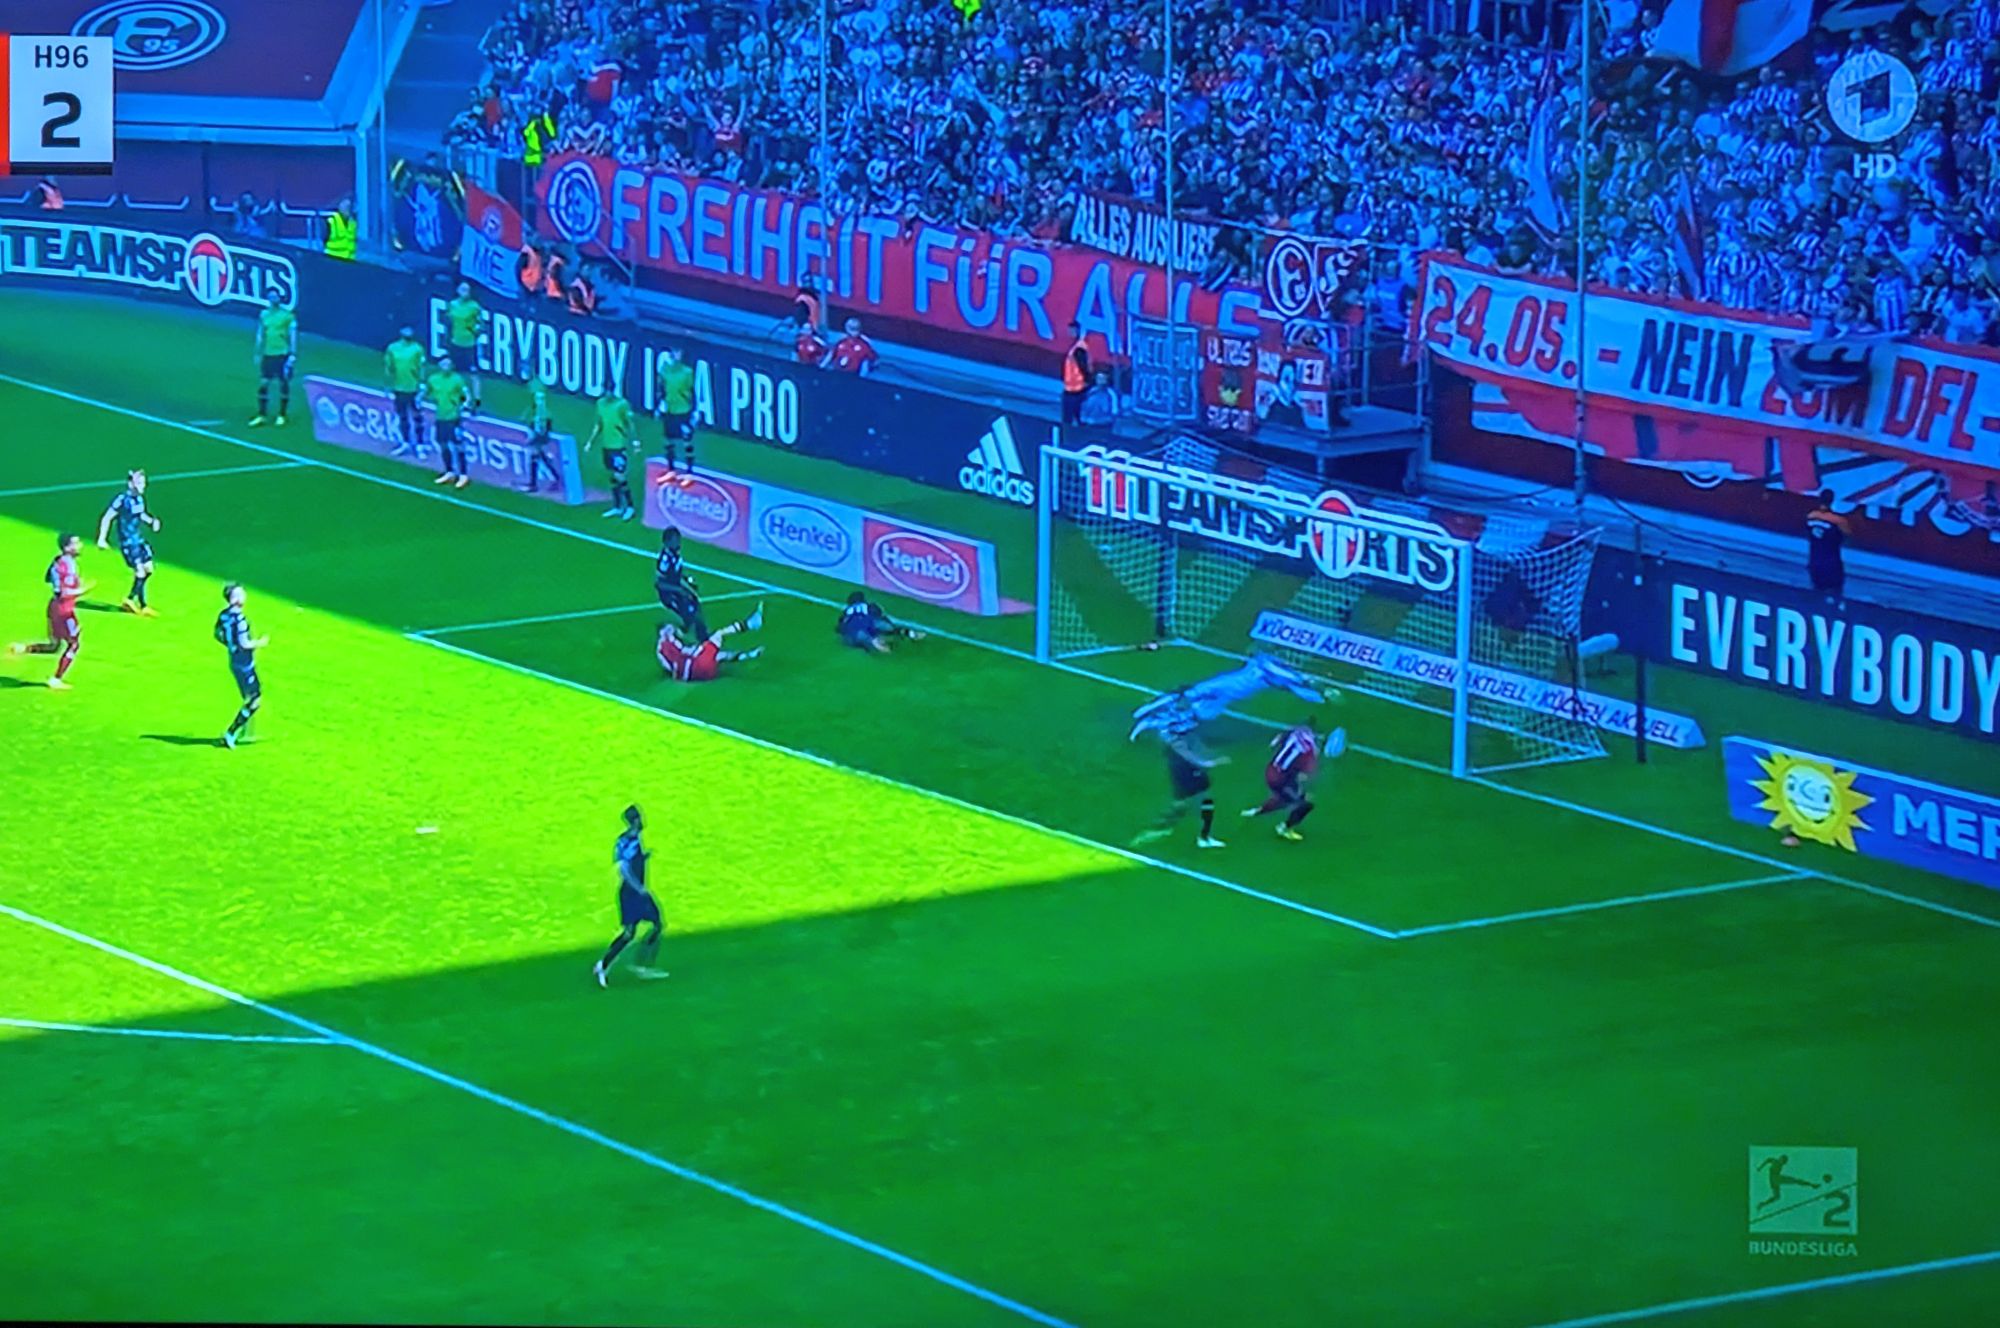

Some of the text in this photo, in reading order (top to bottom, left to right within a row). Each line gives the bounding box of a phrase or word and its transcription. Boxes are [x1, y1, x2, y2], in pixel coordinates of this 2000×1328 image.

[34, 44, 89, 69] H96
[41, 91, 82, 148] 2
[1853, 153, 1897, 179] HD
[1070, 193, 1131, 257] ALLES
[611, 168, 899, 304] FREIHEIT
[913, 228, 1054, 341] FÜR
[1426, 275, 1578, 379] 24.05.
[1631, 319, 1755, 407] NEIN
[430, 298, 628, 398] EERYBODY
[730, 367, 798, 444] PRO
[665, 487, 729, 521] Henkel
[960, 466, 1035, 505] adidas
[767, 515, 844, 552] Henkel
[882, 544, 960, 584] Henkel
[1671, 584, 2000, 733] EVERYBODY
[1258, 617, 1318, 648] KÜCHEN
[1319, 634, 1386, 666] AKTUELL
[1391, 652, 1457, 684] KÜCHEN
[1605, 702, 1680, 742] AKELL
[1823, 1190, 1850, 1227] 2
[1749, 1240, 1858, 1257] BUNDESLIGA
